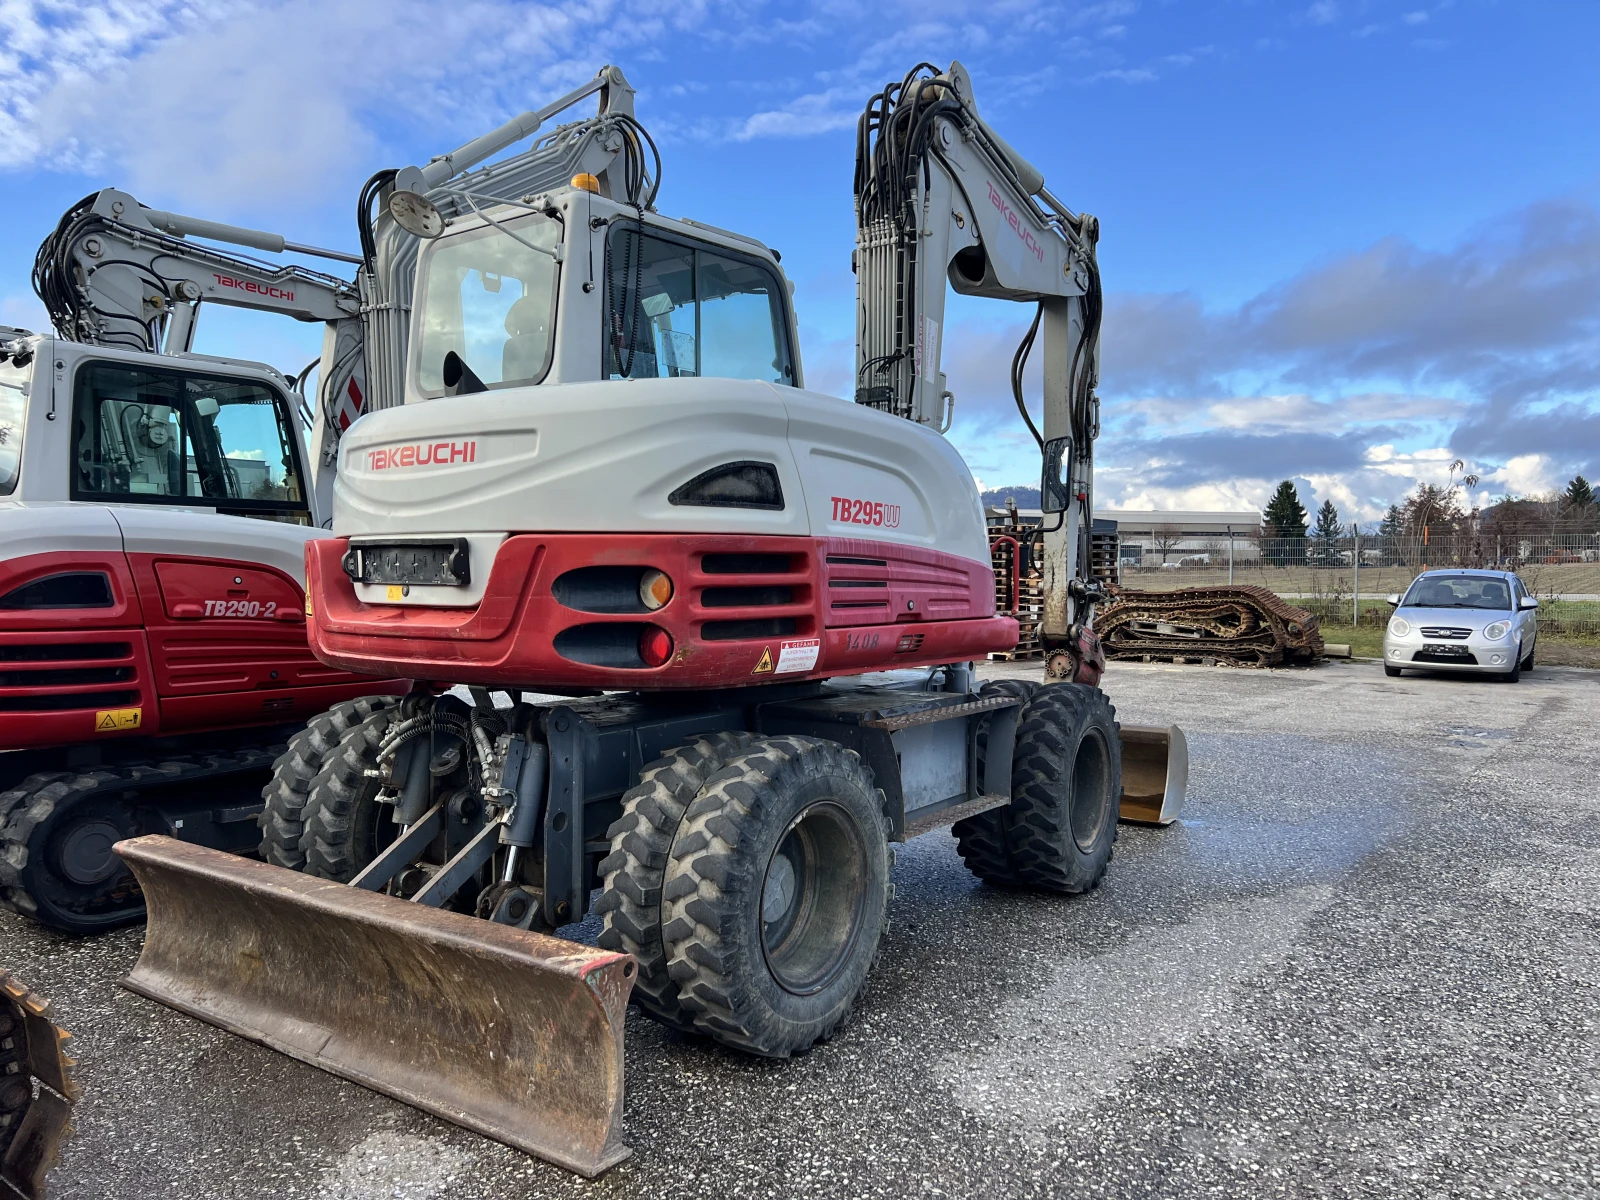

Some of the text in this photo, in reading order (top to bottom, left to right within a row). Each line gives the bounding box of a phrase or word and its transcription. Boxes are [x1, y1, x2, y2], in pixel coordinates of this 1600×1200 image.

[986, 180, 1044, 263] TAKEUCHI
[213, 273, 294, 302] TAKEUCHI
[368, 441, 476, 471] TAKEUCHI
[831, 496, 901, 528] TB295W
[204, 600, 277, 617] TB290-2
[845, 633, 880, 651] 1408
